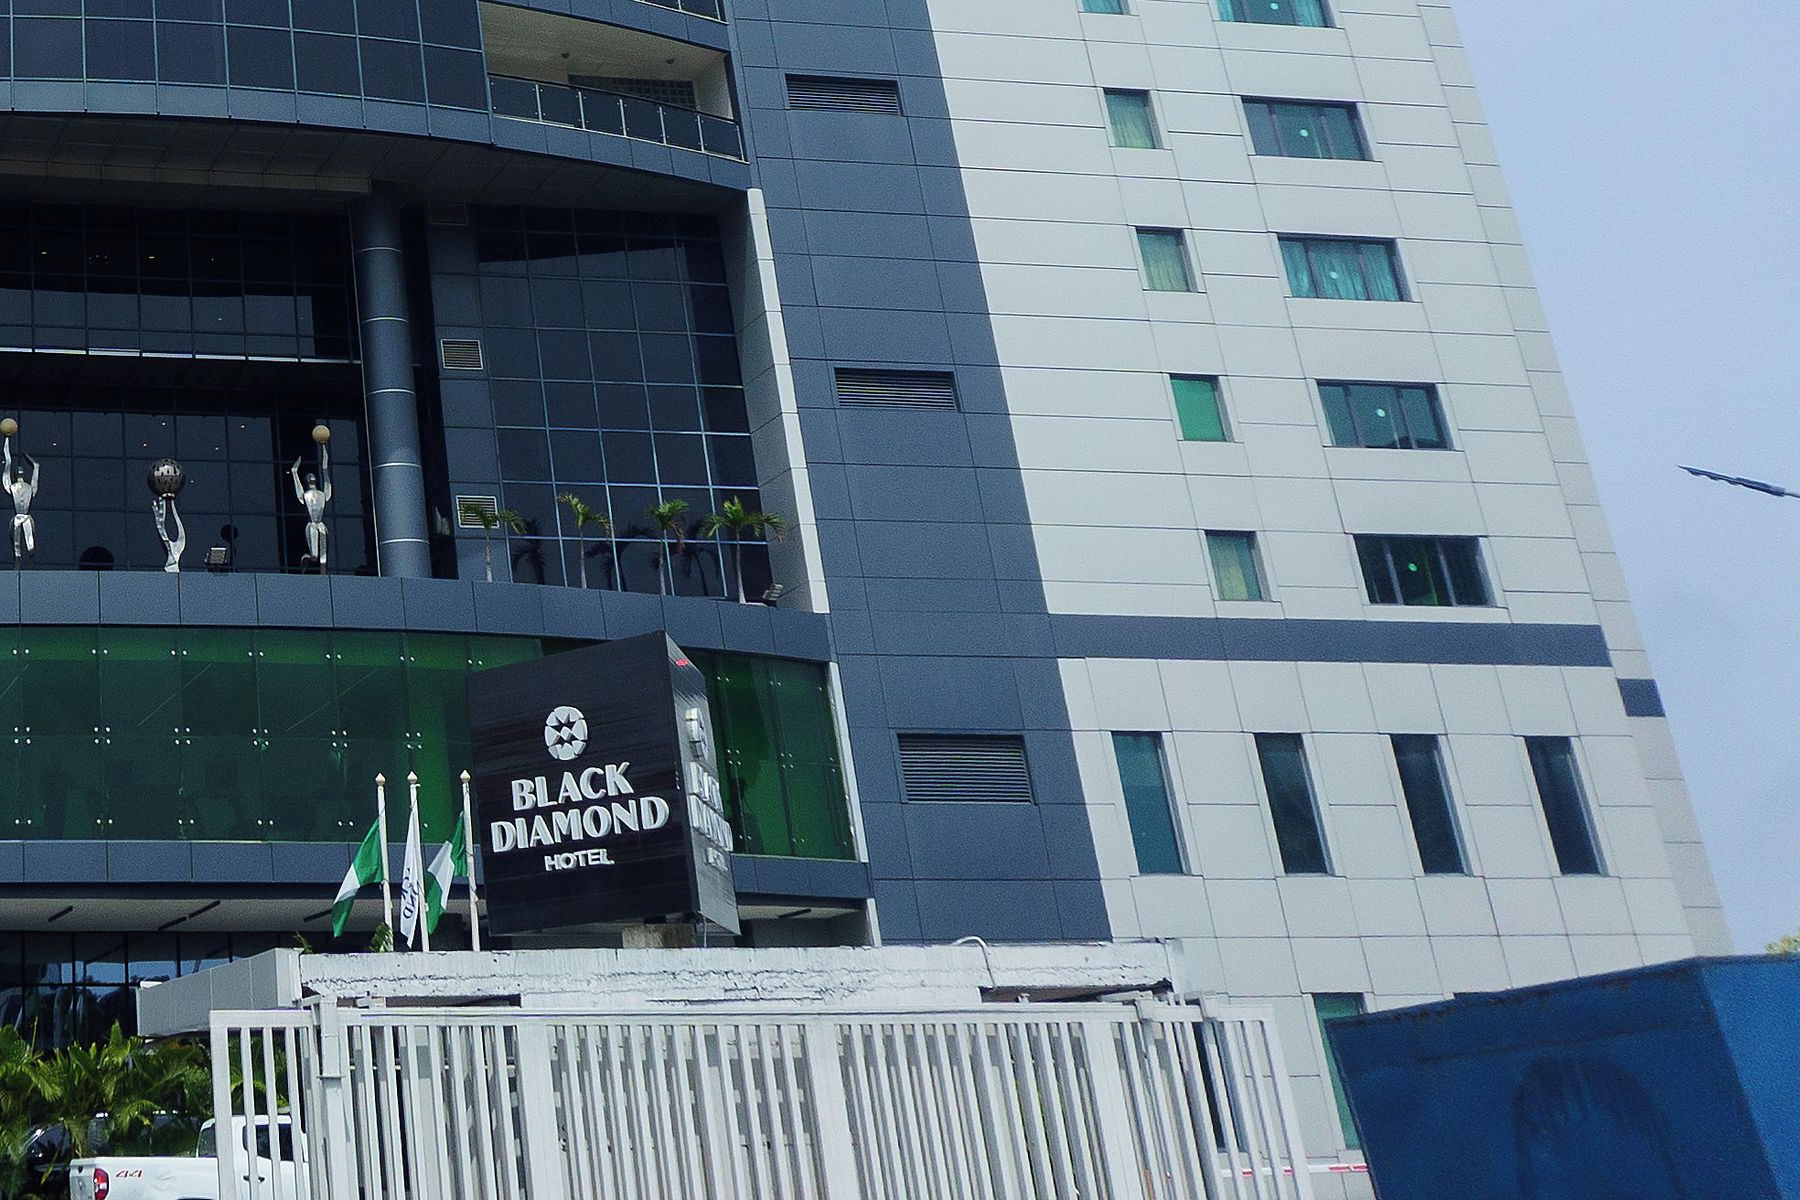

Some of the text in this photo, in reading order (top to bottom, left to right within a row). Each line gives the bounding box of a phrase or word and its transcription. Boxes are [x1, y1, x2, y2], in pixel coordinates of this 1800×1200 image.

[511, 761, 635, 811] BLACK
[490, 796, 670, 853] DIAMOND
[544, 848, 615, 871] HOTEL
